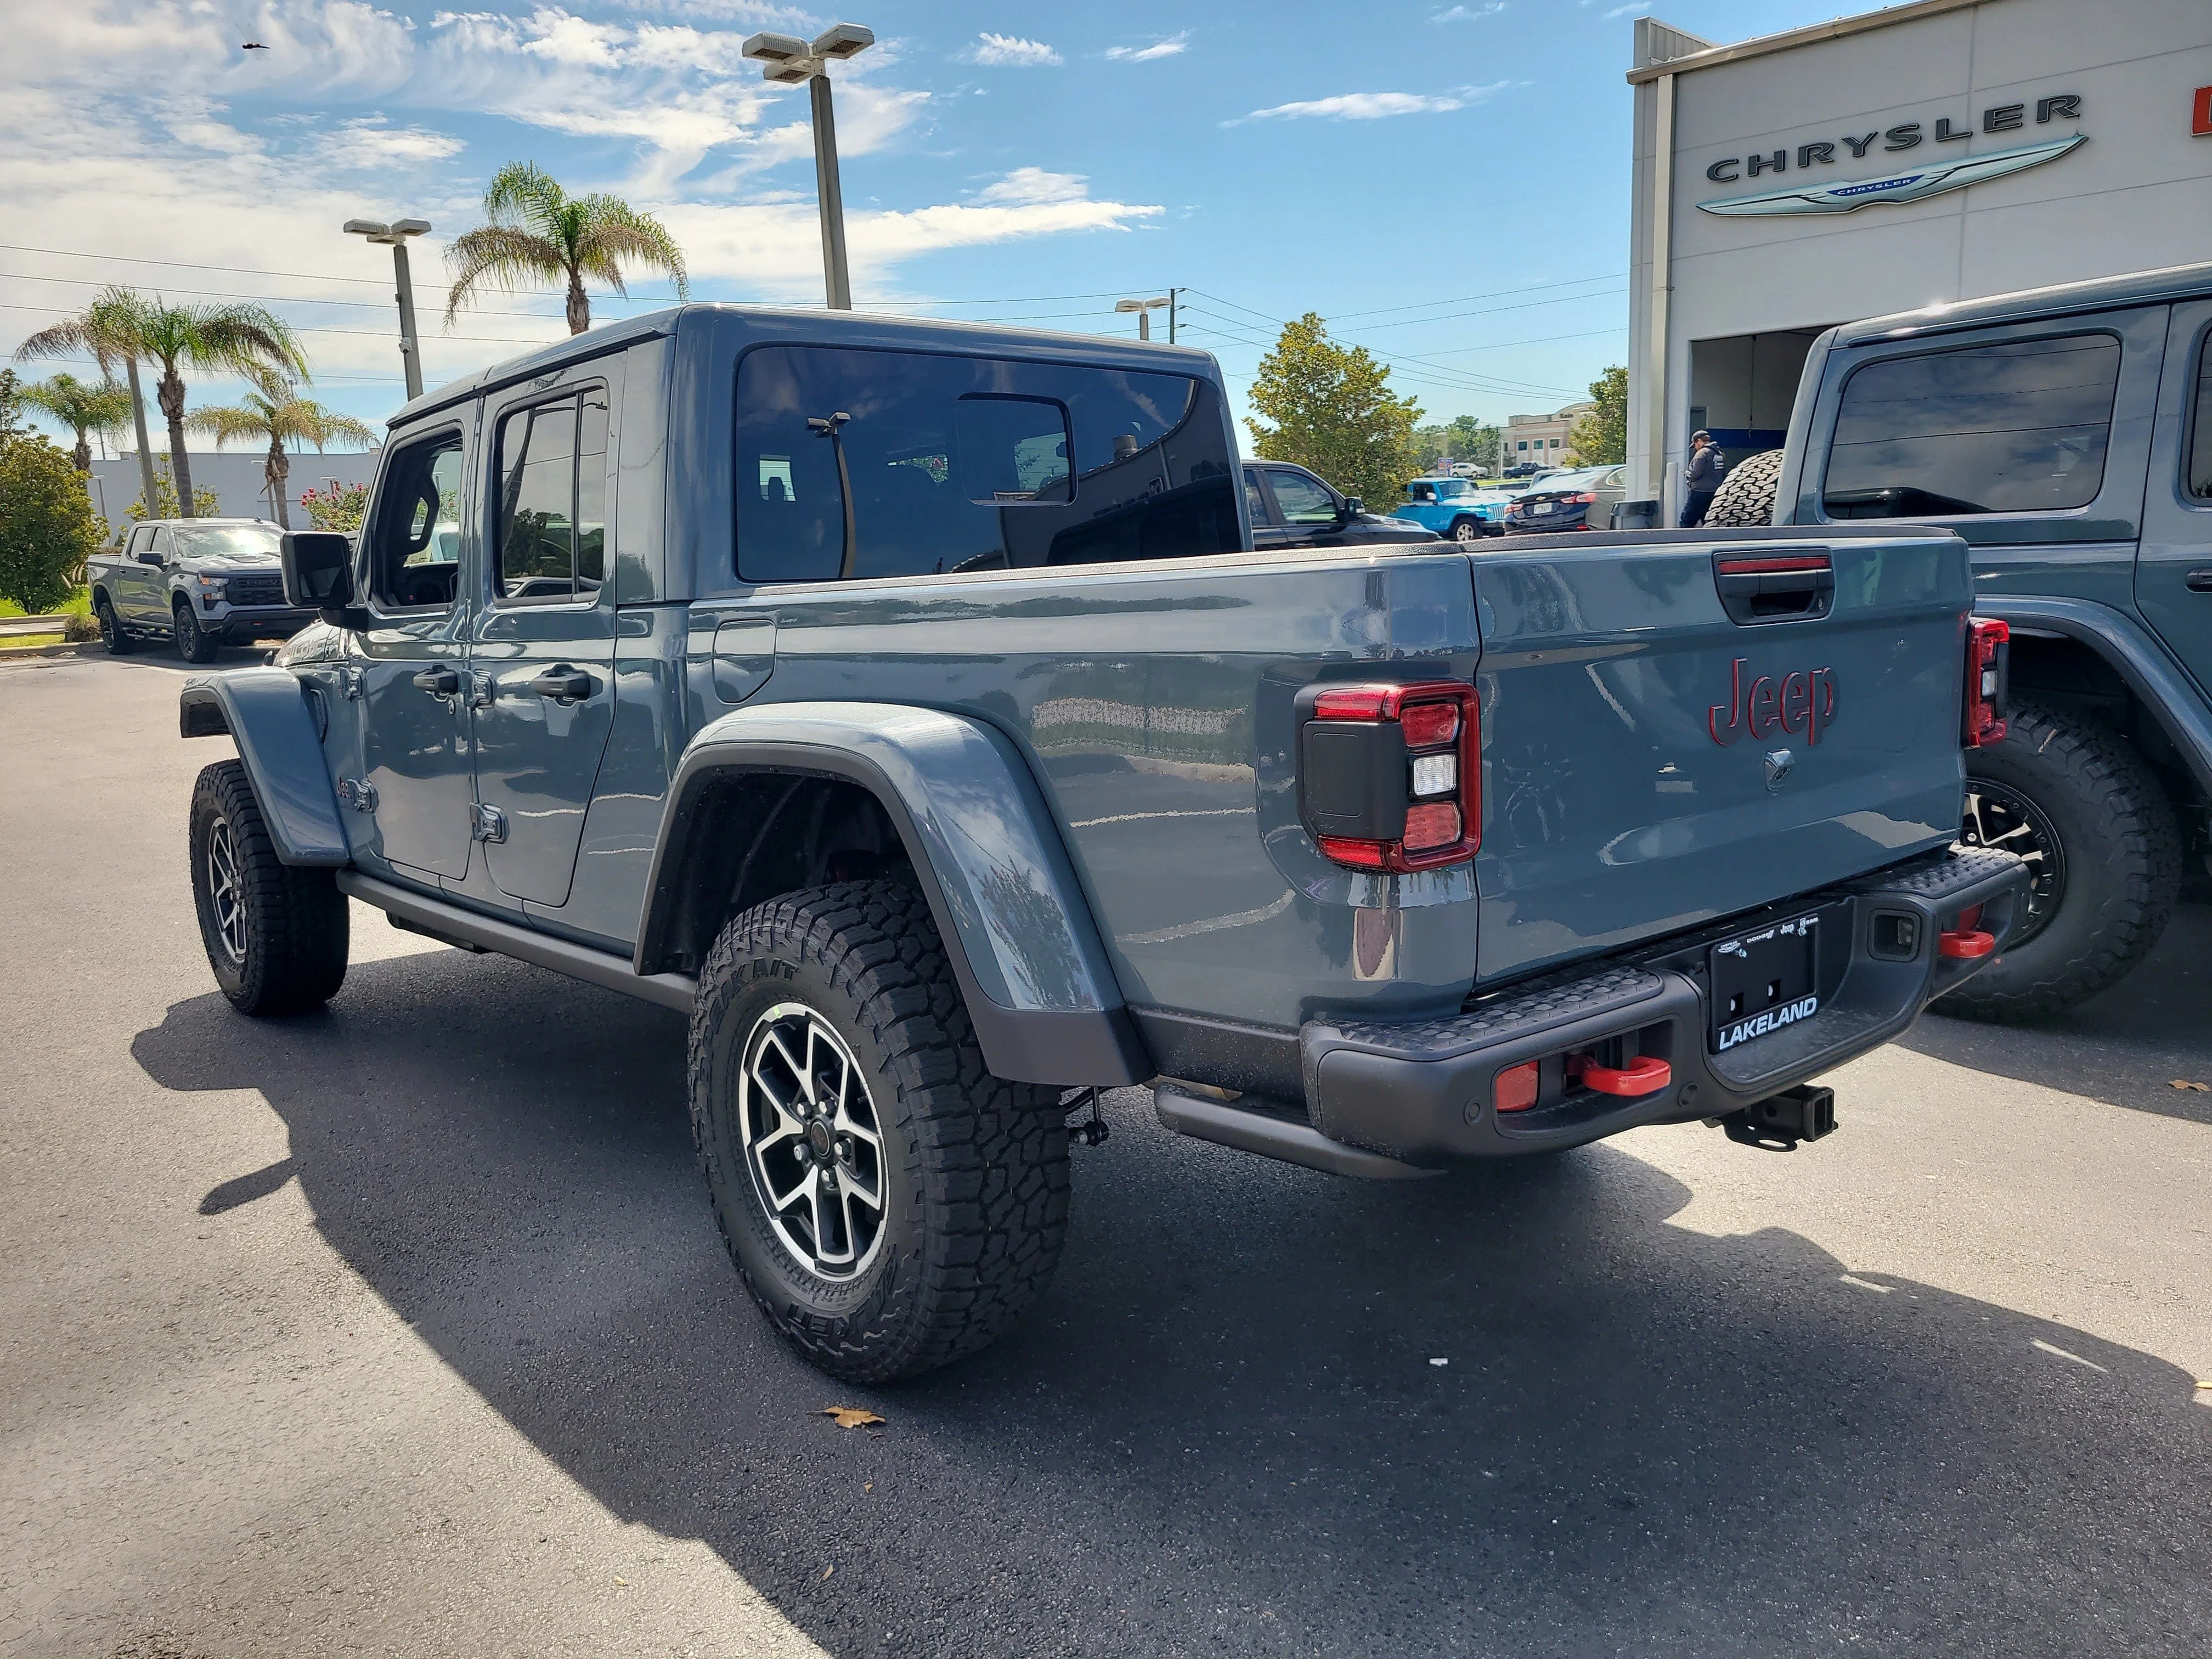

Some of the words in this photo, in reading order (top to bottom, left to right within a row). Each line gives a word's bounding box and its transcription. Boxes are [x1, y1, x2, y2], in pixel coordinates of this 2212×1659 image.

[1706, 94, 2081, 183] CHRYSLER
[1837, 178, 1912, 195] CHRYSLER
[1709, 658, 1840, 747] Jeep
[337, 776, 353, 800] Jee
[1780, 924, 1794, 934] Jeep
[1718, 997, 1818, 1050] LAKELAND
